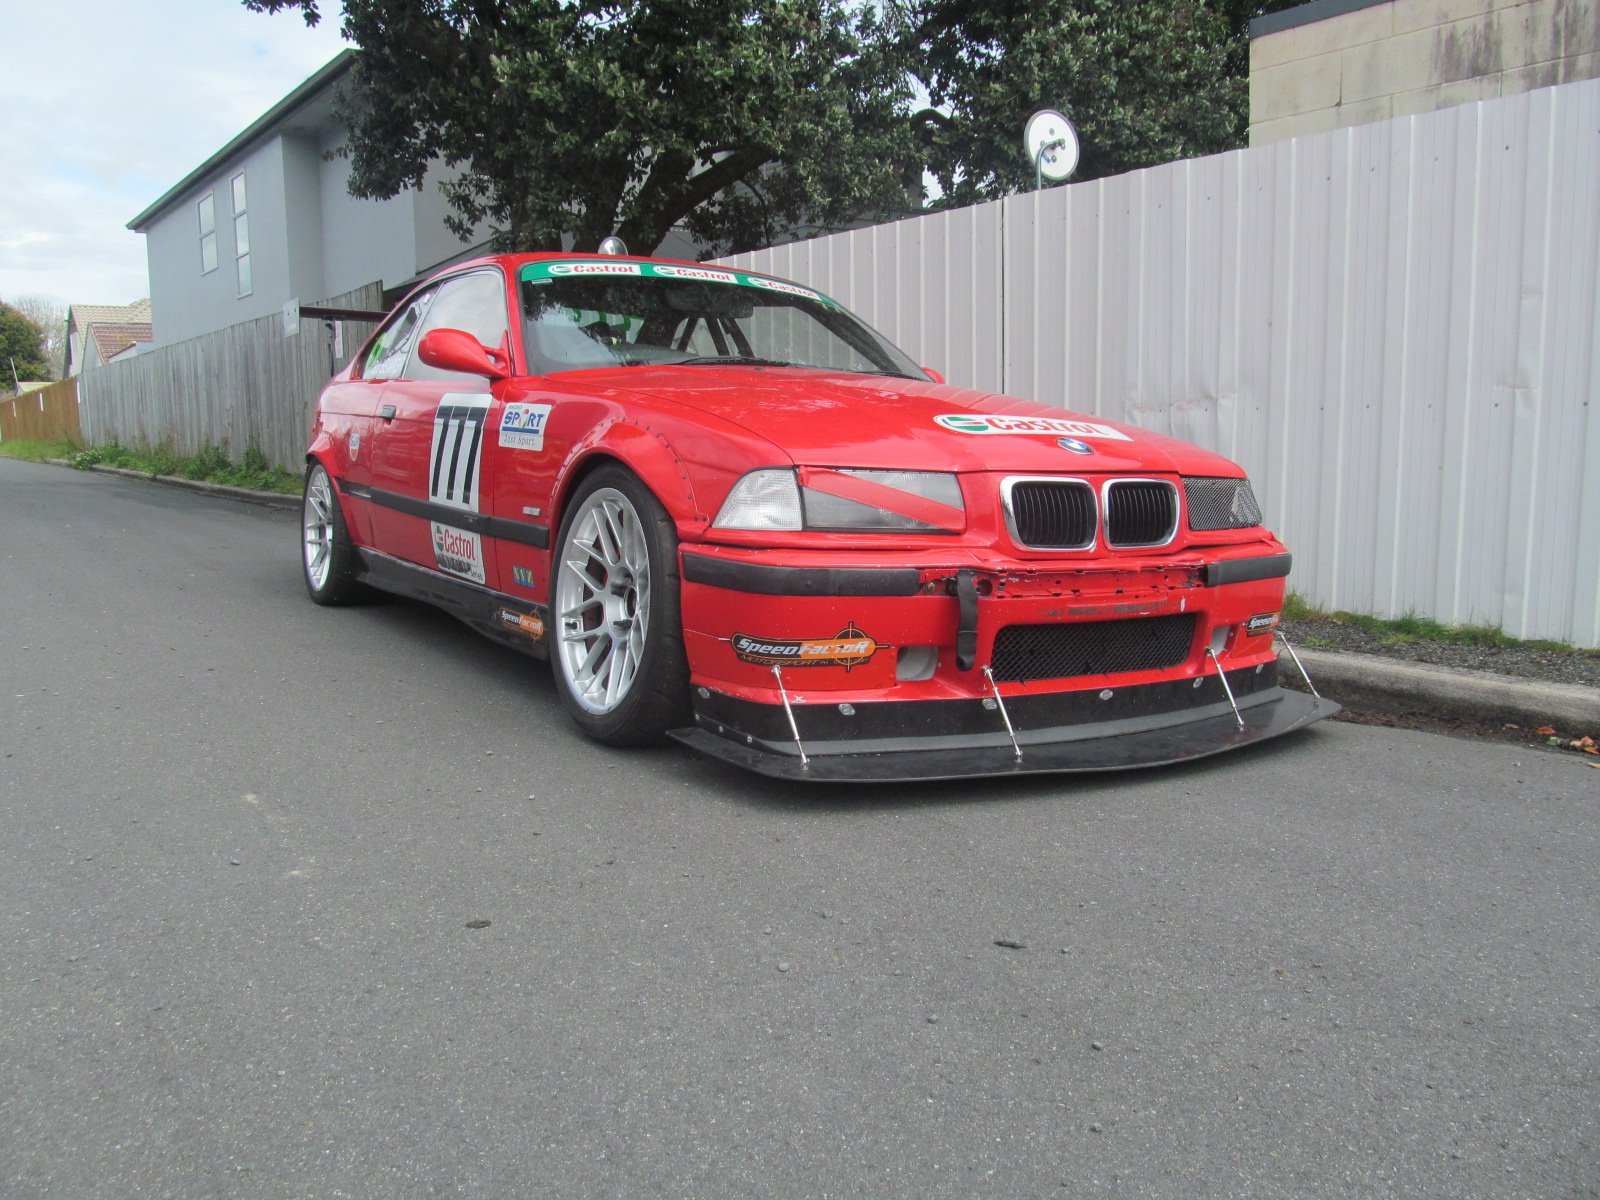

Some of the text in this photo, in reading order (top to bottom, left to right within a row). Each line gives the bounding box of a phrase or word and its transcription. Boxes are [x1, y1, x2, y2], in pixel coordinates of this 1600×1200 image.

[573, 265, 634, 273] Castrol
[676, 268, 733, 281] Castrol
[768, 281, 815, 297] Castrol
[985, 417, 1107, 435] Castrol
[503, 434, 517, 444] Just
[444, 528, 476, 561] Castrol
